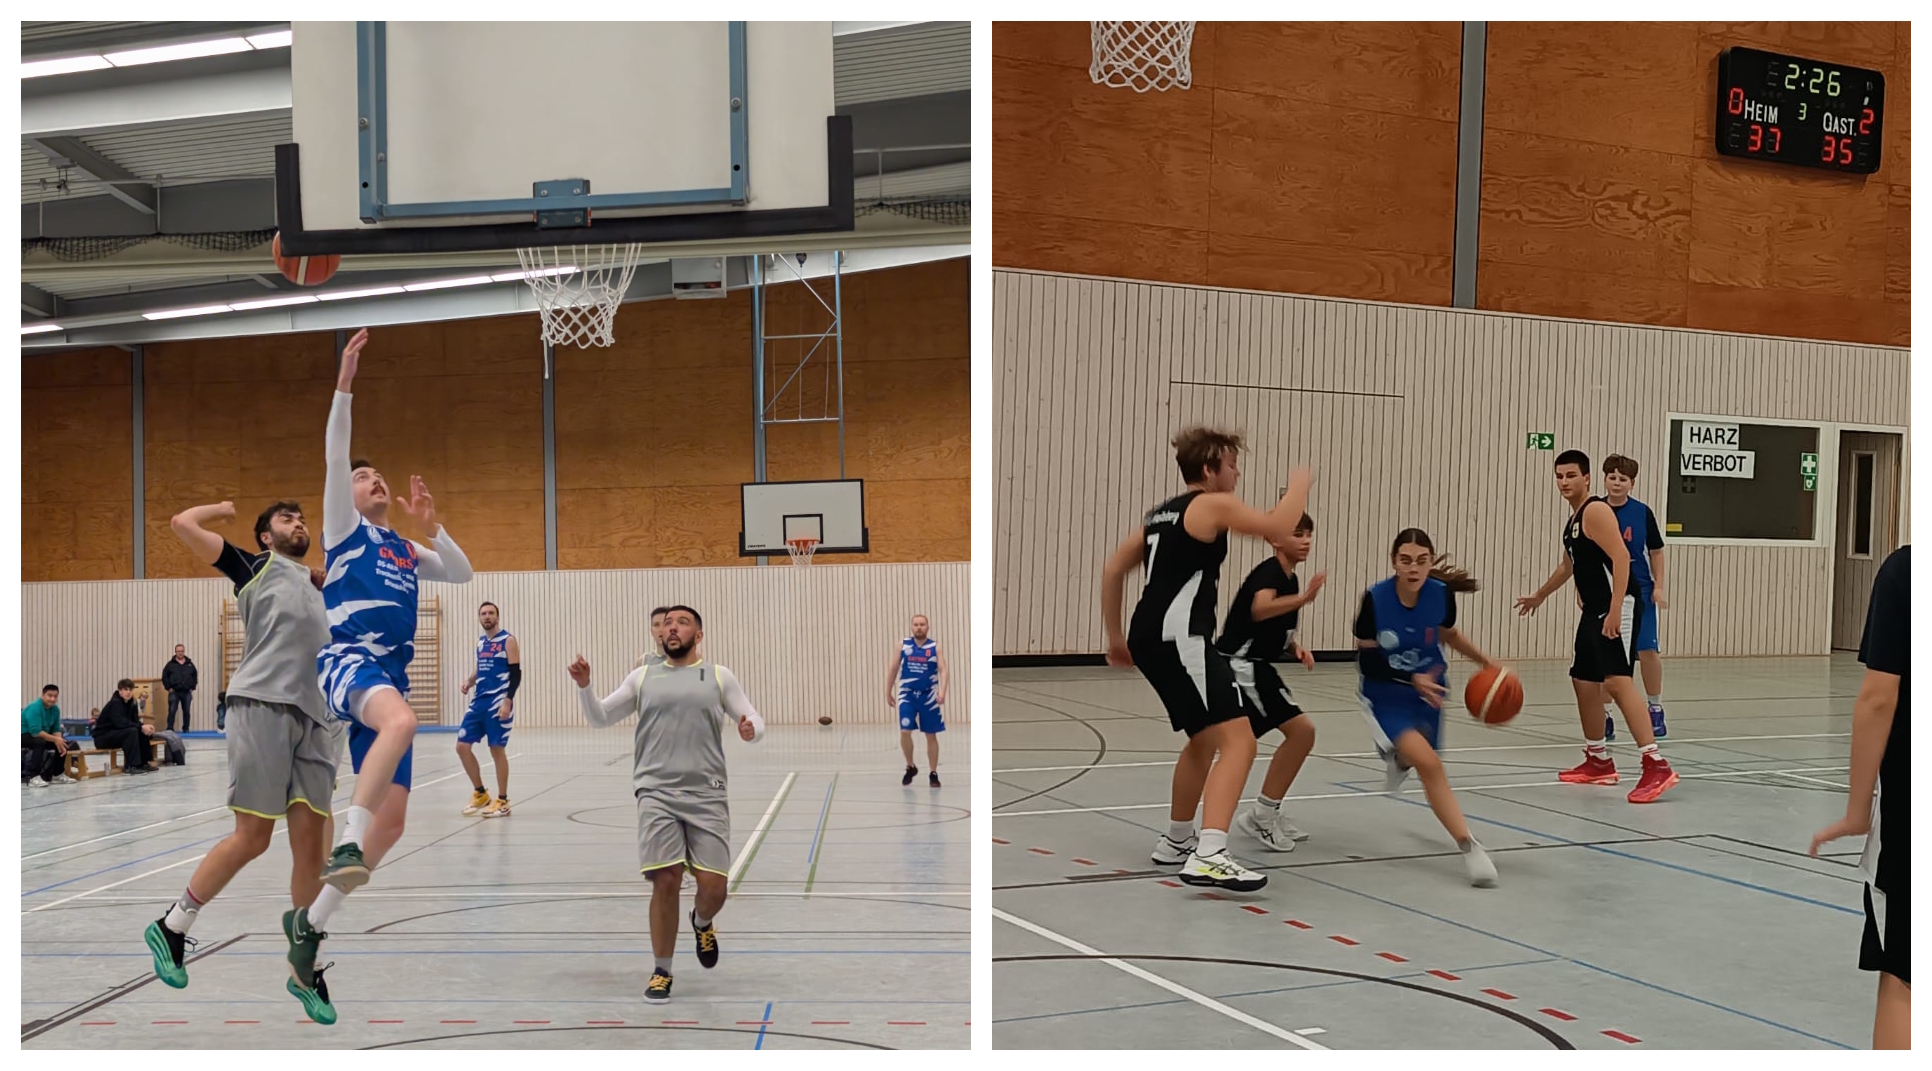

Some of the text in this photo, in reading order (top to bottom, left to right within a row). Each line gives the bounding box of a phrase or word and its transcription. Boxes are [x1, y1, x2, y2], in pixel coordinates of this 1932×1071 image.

[1784, 63, 1841, 97] 2:26
[1744, 99, 1779, 124] HEIM
[1797, 102, 1808, 121] 3
[1859, 108, 1875, 135] 2
[1748, 125, 1782, 154] 37
[1821, 135, 1853, 164] 35
[1689, 426, 1738, 445] HARZ
[1682, 453, 1747, 472] VERBOT
[490, 643, 502, 652] 24
